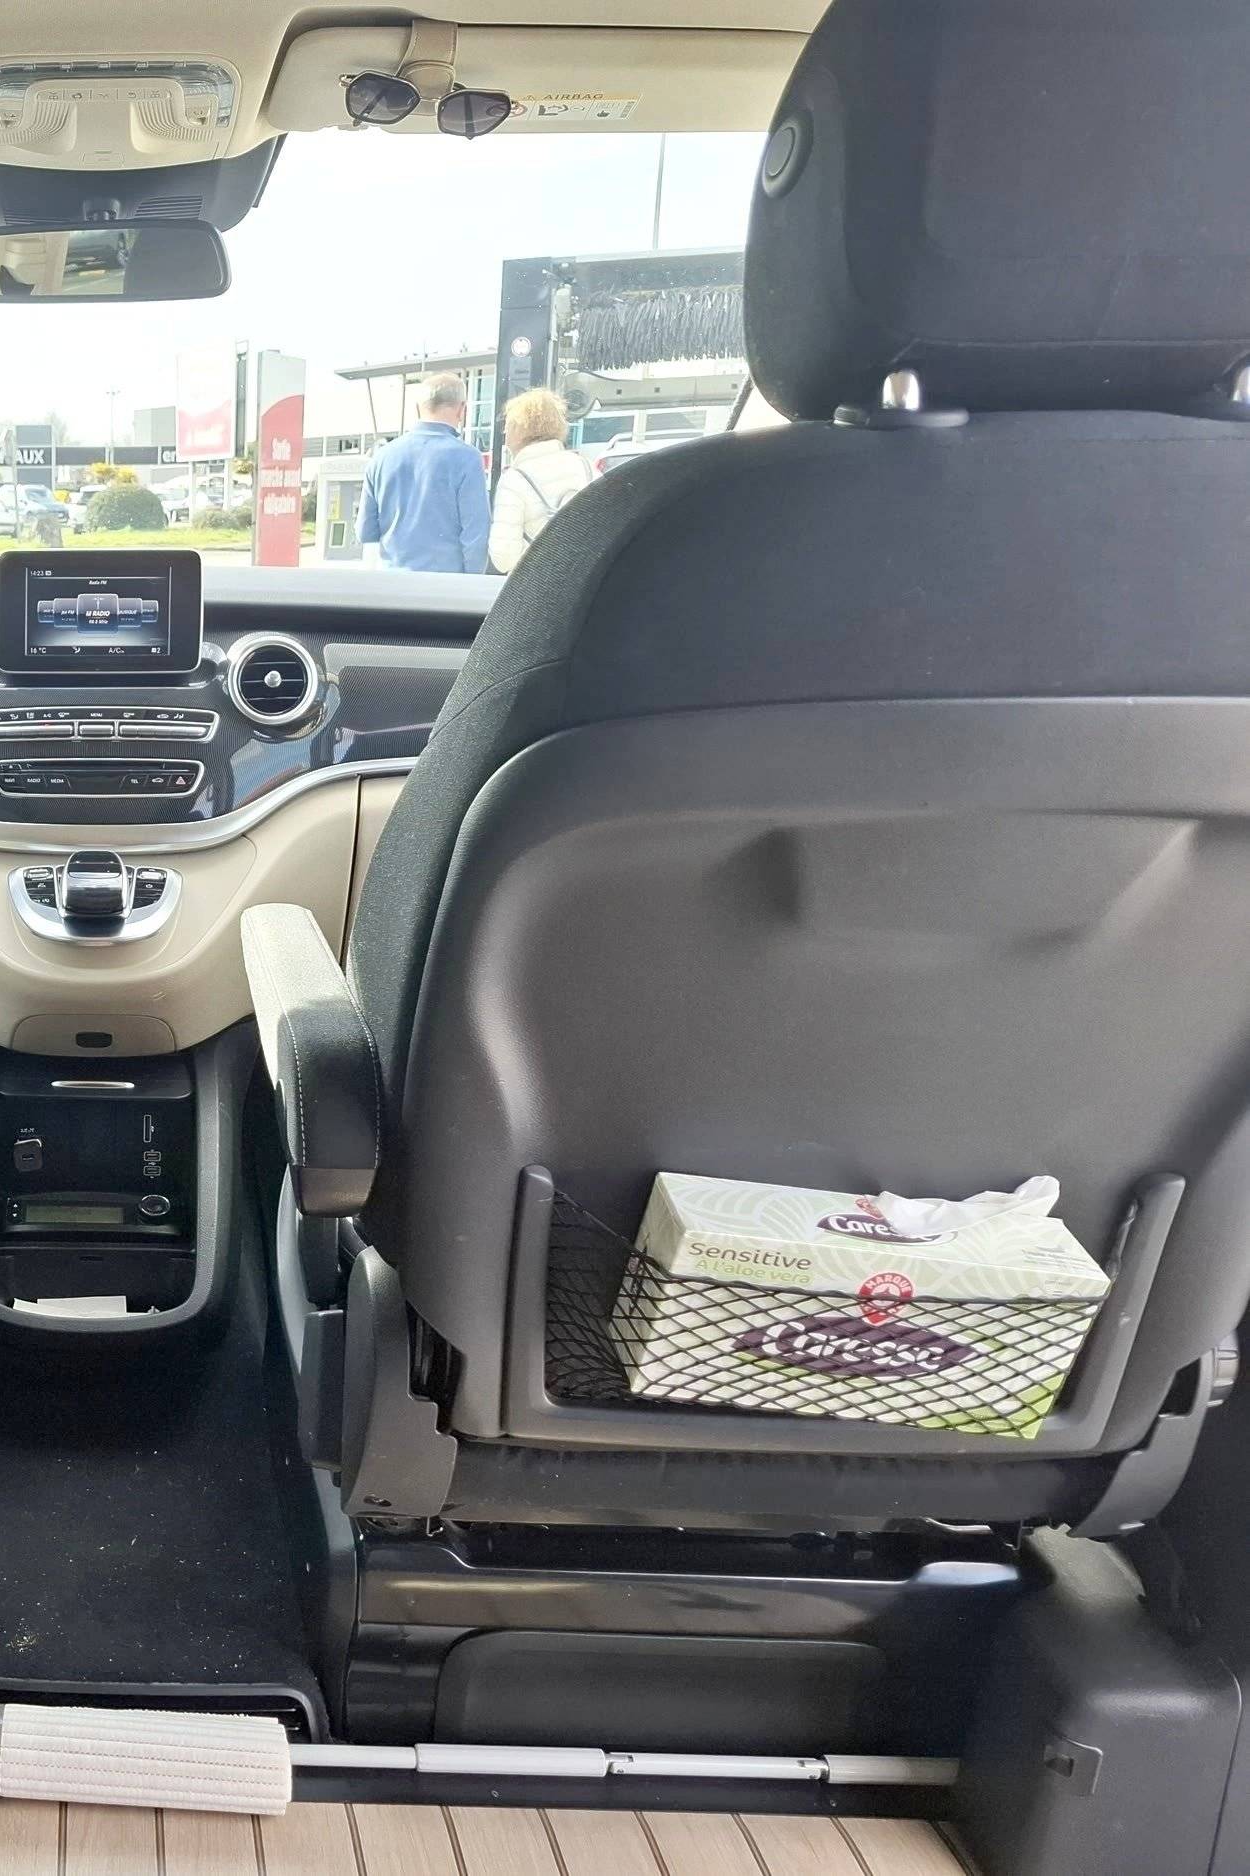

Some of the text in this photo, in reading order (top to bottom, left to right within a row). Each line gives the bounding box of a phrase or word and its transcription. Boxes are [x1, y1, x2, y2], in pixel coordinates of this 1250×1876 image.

[689, 1241, 812, 1271] Sensitive
[770, 1270, 811, 1284] vera
[864, 1274, 912, 1292] MARQUE
